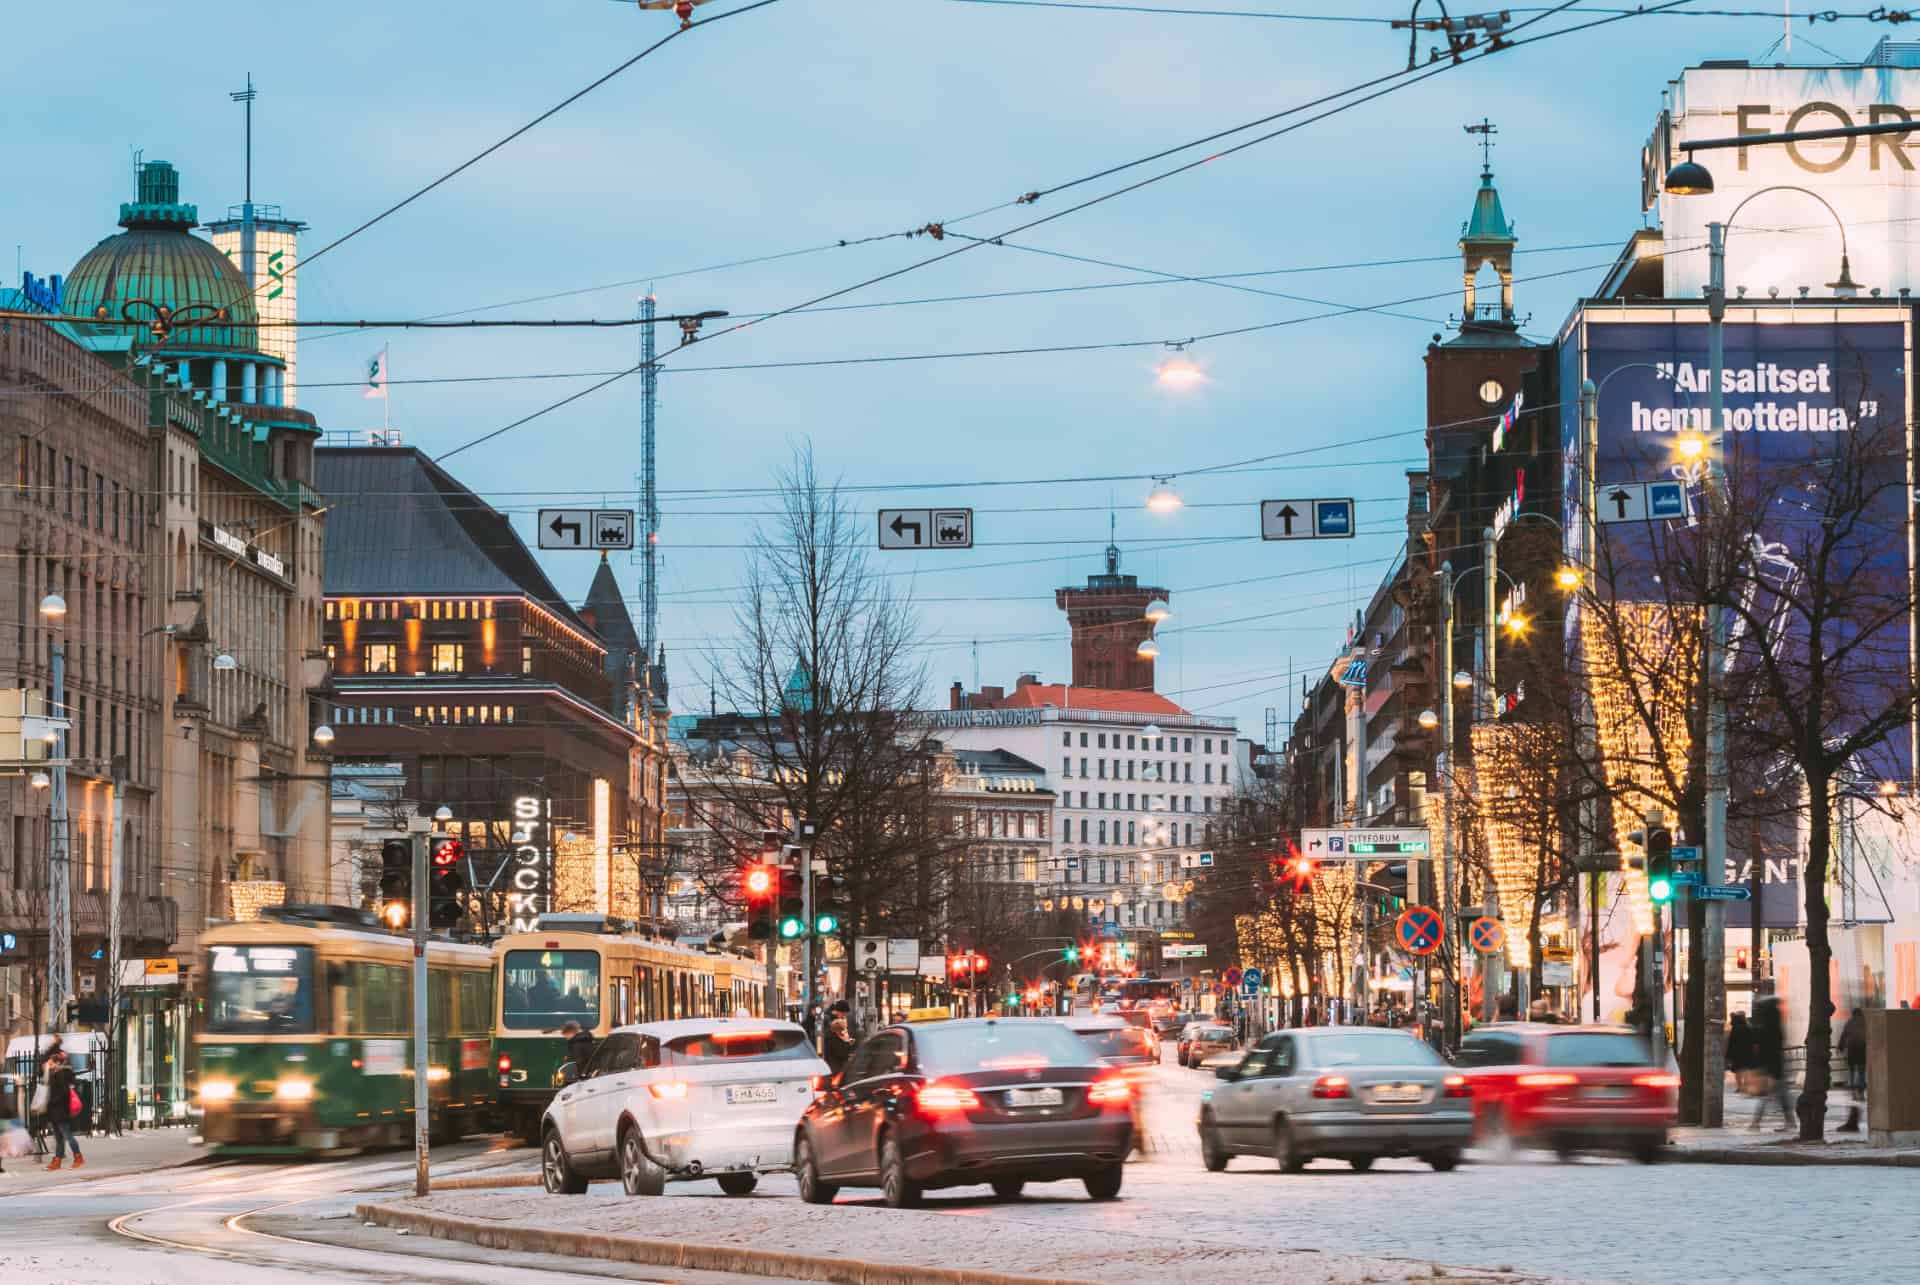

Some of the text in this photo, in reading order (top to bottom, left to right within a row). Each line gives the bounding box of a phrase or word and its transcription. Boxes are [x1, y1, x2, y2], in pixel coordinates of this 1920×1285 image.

[1737, 101, 1915, 174] FOR
[1349, 834, 1399, 843] CITYFORUM
[1724, 858, 1804, 884] GANT
